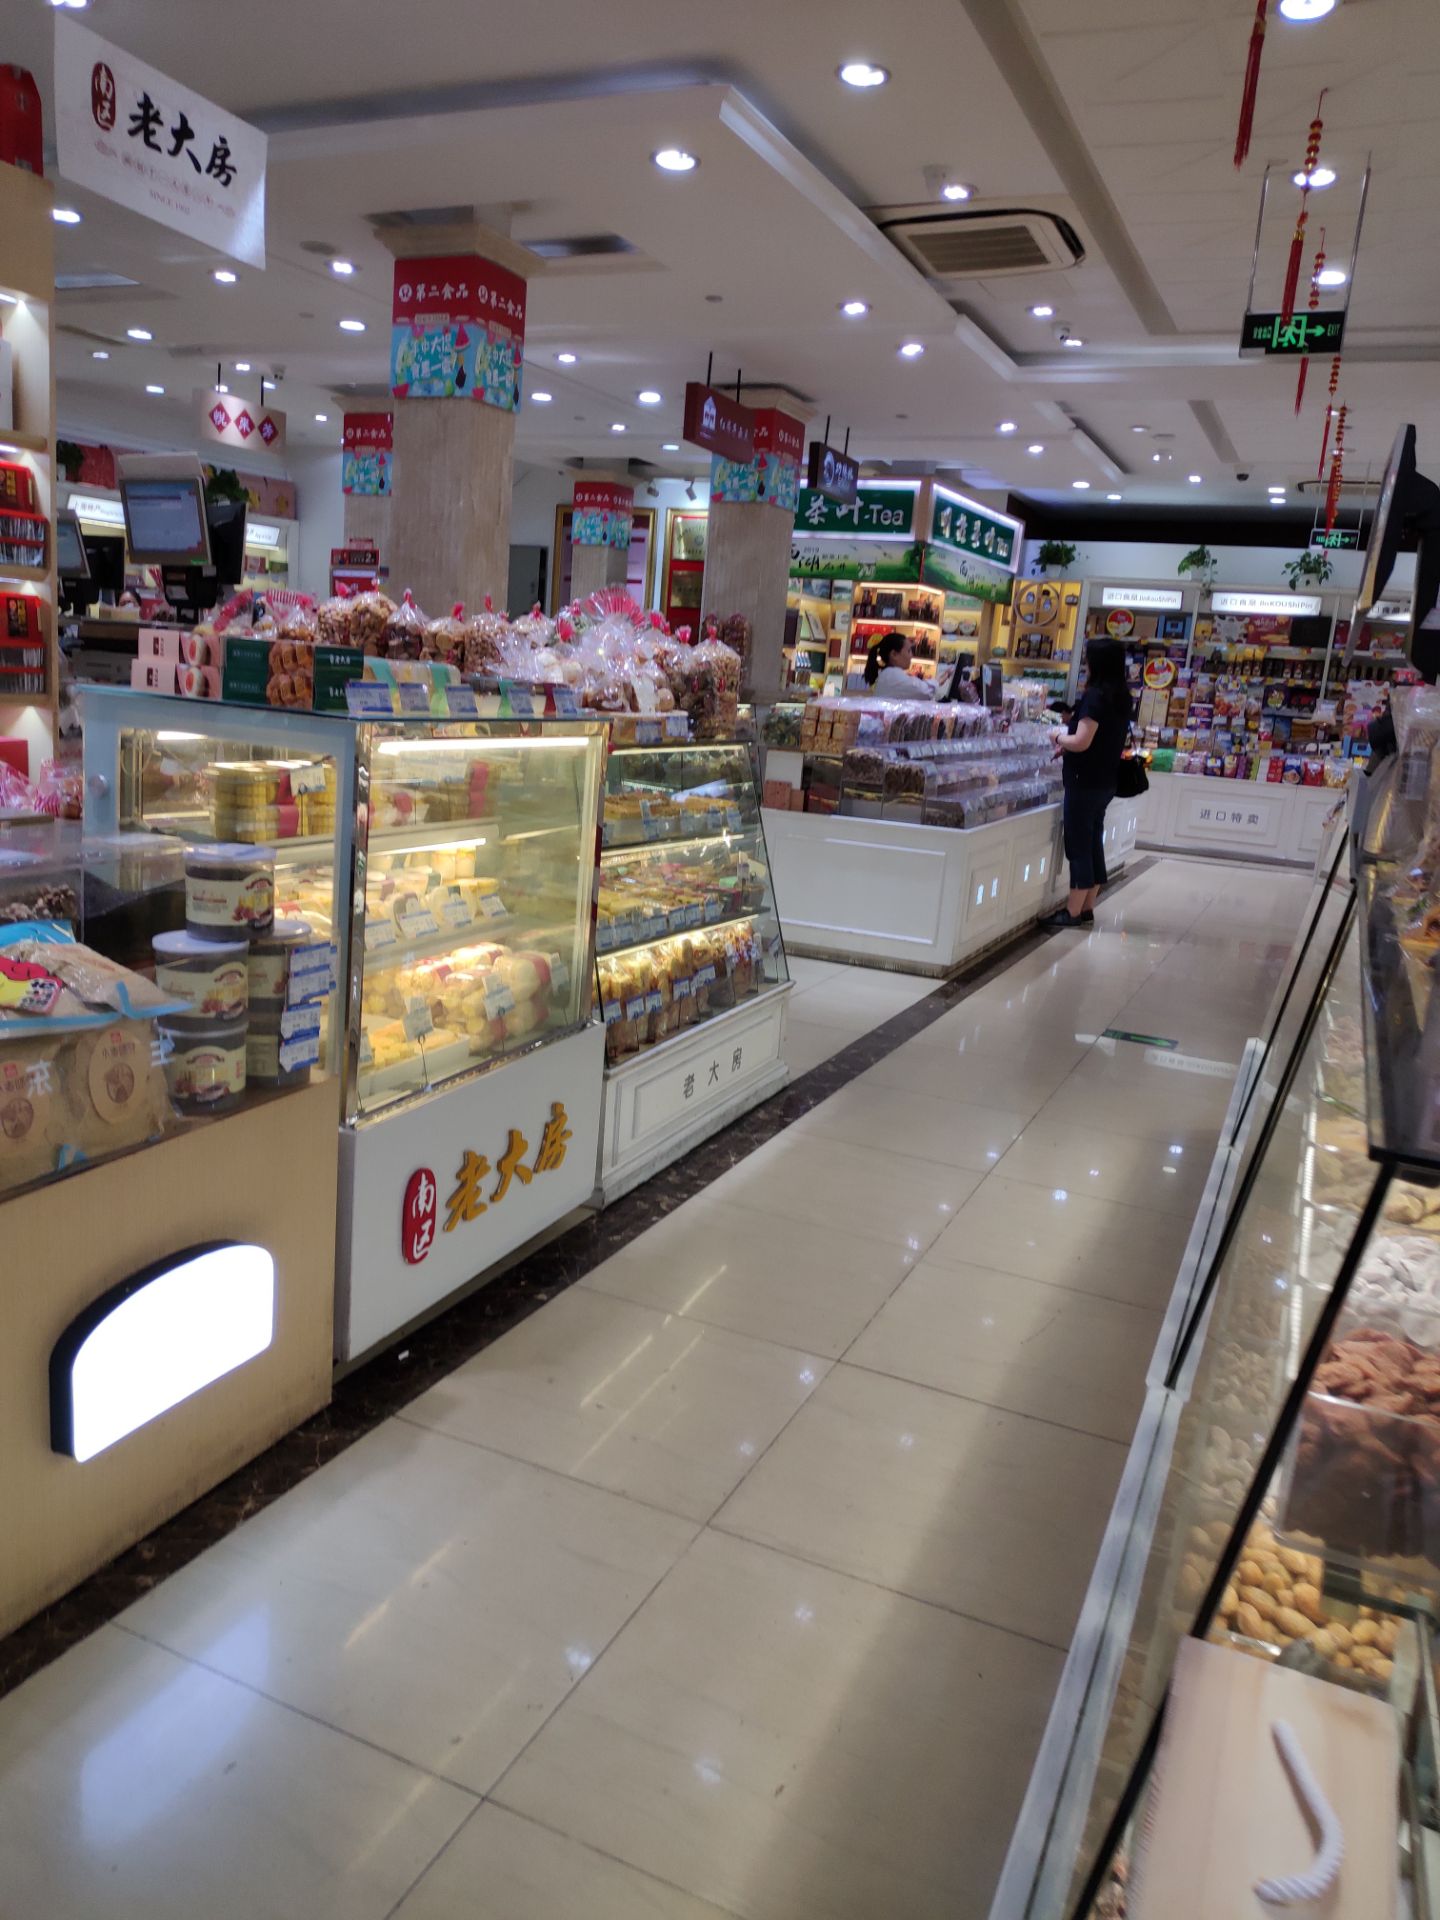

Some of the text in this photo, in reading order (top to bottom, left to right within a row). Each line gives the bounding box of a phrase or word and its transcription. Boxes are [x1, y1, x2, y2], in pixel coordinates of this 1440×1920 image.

[95, 64, 113, 131] 南区
[128, 91, 237, 188] 老大房
[416, 282, 468, 302] 第二食品
[490, 291, 522, 320] 第二食品
[1327, 323, 1341, 337] EXIT
[805, 494, 865, 526] 茶叶
[869, 504, 905, 526] Tea
[1199, 808, 1260, 825] 进口特卖
[682, 1046, 743, 1100] 老大房
[443, 1101, 574, 1233] 老大房
[412, 1172, 435, 1261] 南区
